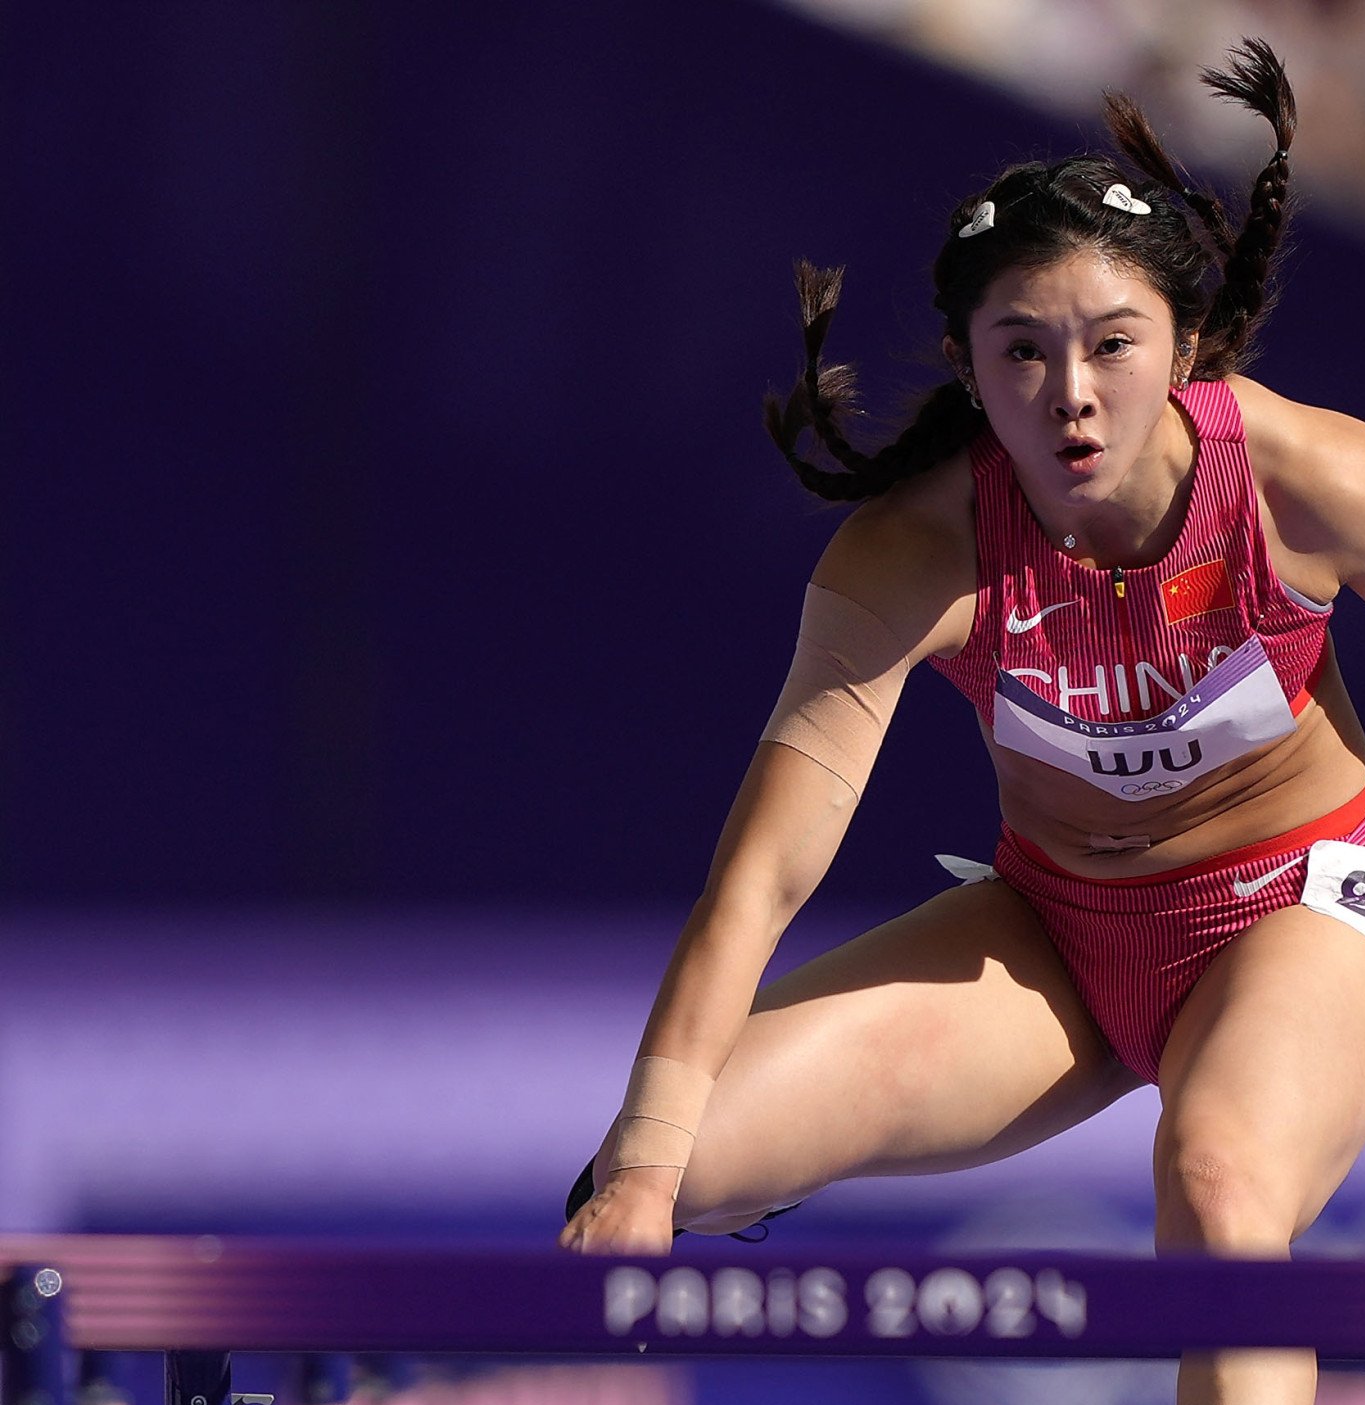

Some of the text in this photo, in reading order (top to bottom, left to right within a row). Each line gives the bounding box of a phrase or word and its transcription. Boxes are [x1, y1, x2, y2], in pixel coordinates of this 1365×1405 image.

[1144, 694, 1201, 732] 2024
[1087, 738, 1203, 777] WU
[864, 1266, 1088, 1339] 2024
